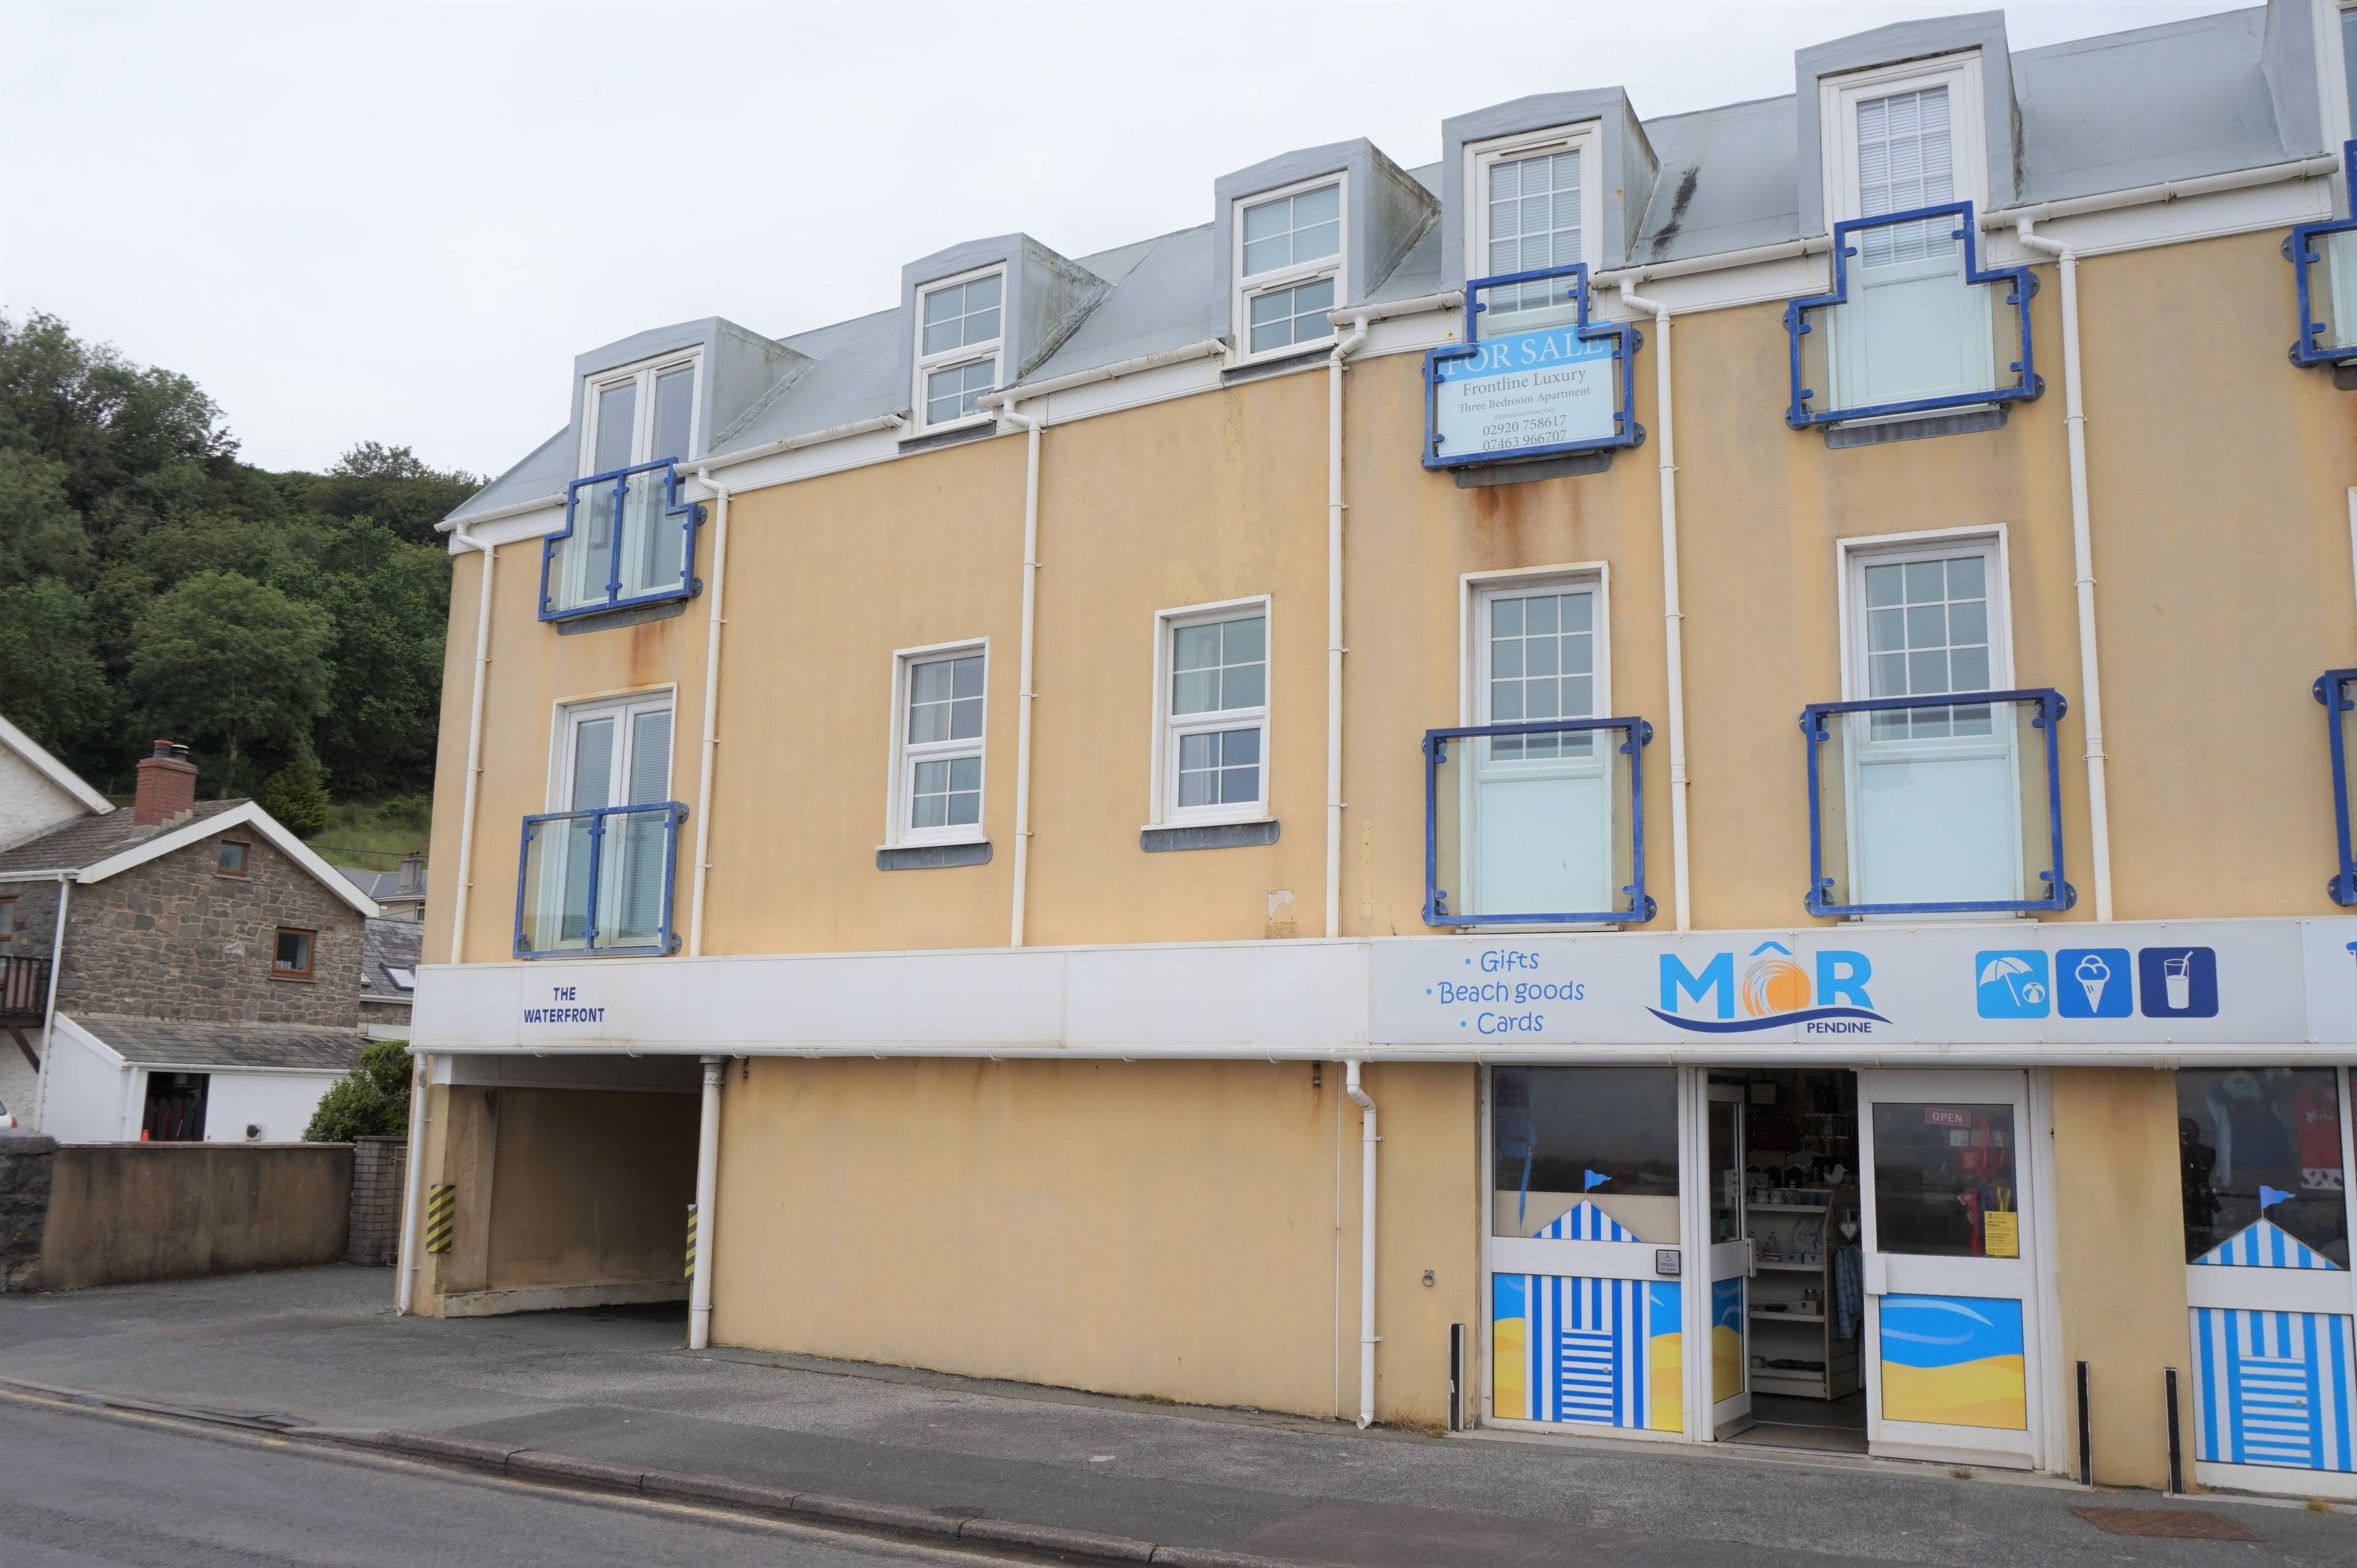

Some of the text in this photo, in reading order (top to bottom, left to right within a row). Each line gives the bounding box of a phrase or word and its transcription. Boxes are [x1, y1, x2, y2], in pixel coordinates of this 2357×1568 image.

[1446, 332, 1603, 376] FOR SALE
[1463, 369, 1587, 396] Frontline Luxury
[1458, 387, 1591, 413] Three Bedroom Apartment
[1483, 415, 1566, 436] 02920 758617
[1502, 412, 1526, 420] Enquiries
[1483, 430, 1567, 451] 07463 966707
[1480, 949, 1539, 973] Gifts
[554, 987, 576, 1001] THE
[1438, 980, 1585, 1005] Beach goods
[524, 1008, 605, 1023] WATERFRONT
[1477, 1011, 1544, 1035] Cards
[1806, 1022, 1872, 1033] PENDINE
[1932, 1112, 1962, 1122] OPEN
